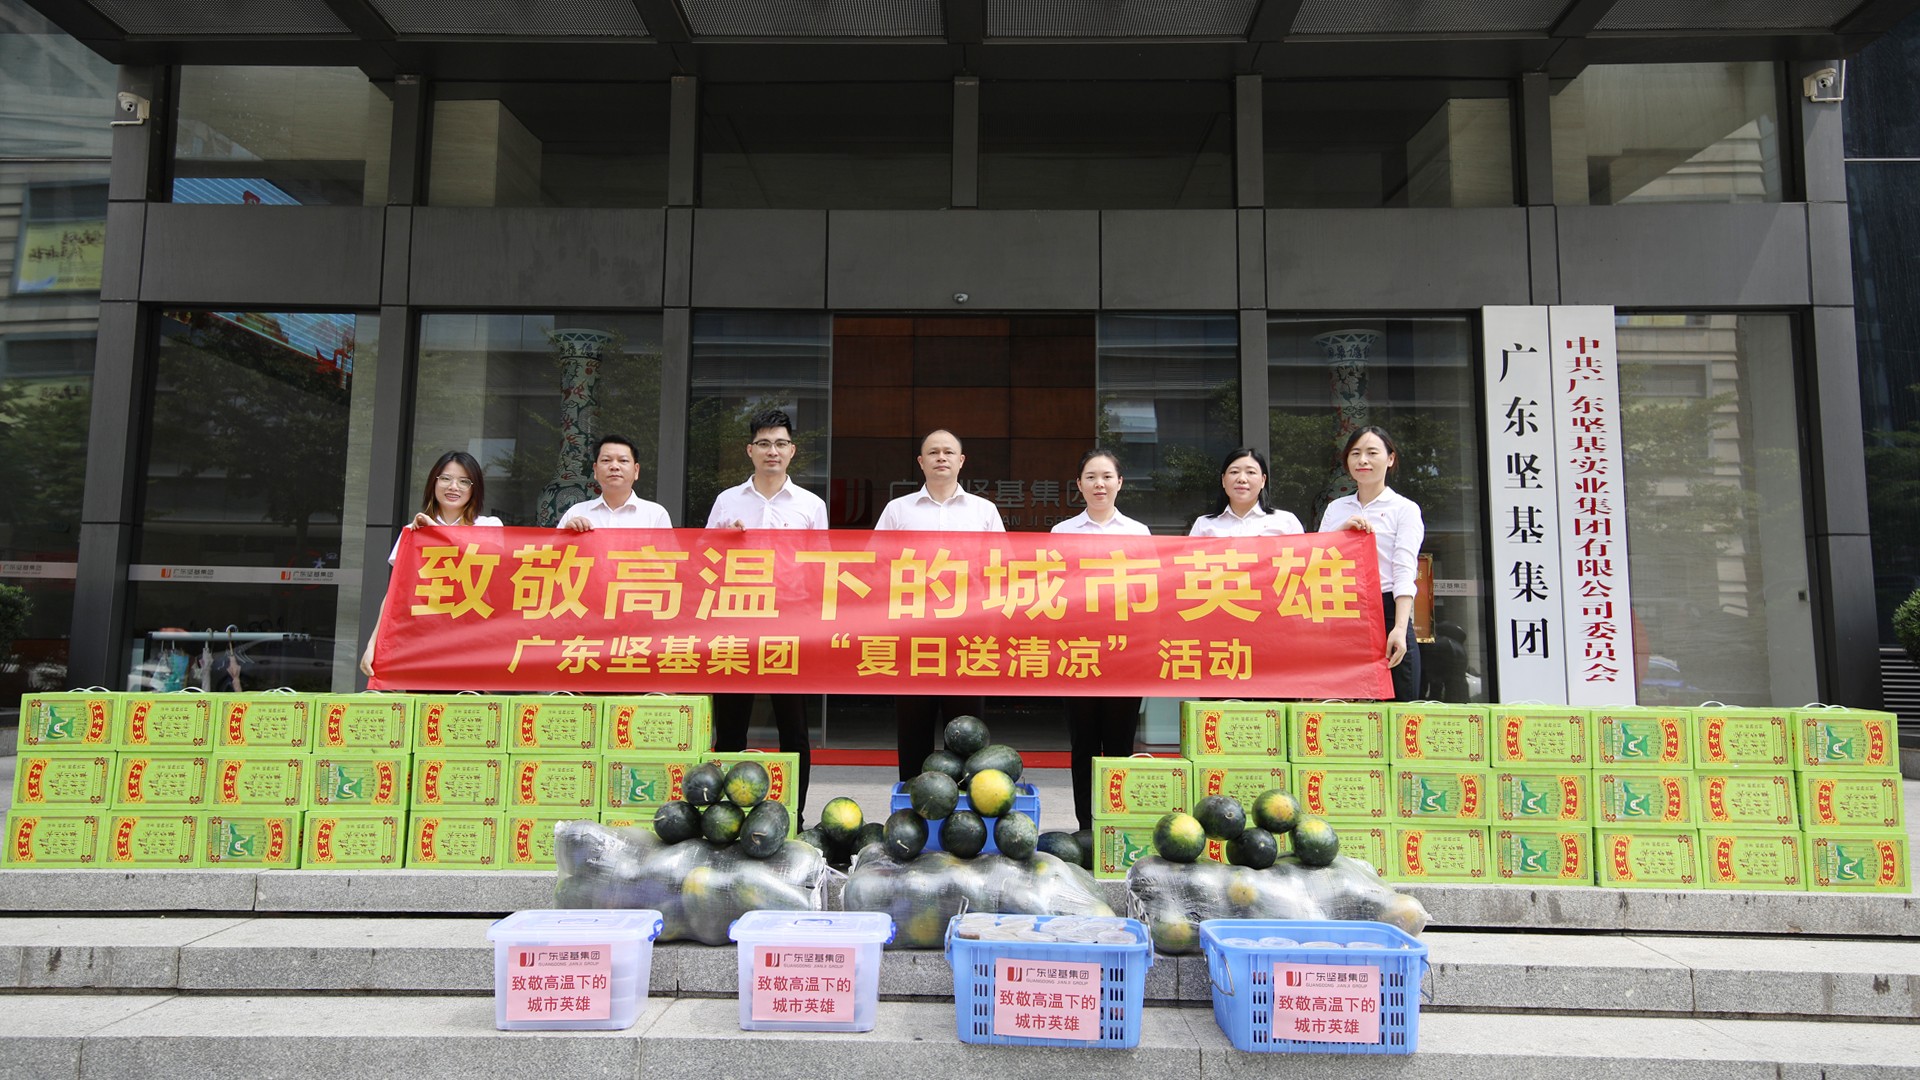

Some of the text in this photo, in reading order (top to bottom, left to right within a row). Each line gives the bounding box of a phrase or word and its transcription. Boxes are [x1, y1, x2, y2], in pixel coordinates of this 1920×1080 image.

[1499, 342, 1549, 660] 广东坚基集团
[1565, 336, 1619, 682] 中共广东坚基实业集团有限公司委员会
[412, 544, 1360, 622] 致敬高温下的城市英雄
[508, 635, 800, 676] 广东坚基集团
[1159, 640, 1254, 680] 活动
[538, 951, 600, 961] 广东坚基集团
[783, 953, 845, 963] 广东坚基集团
[512, 974, 607, 991] 致敬高温下的
[1026, 968, 1089, 980] 广东坚基集团
[1305, 972, 1369, 983] 广东坚基集团
[758, 975, 851, 992] 致敬高温下的
[527, 996, 591, 1012] 城市英雄
[772, 997, 835, 1014] 城市英雄
[1000, 990, 1096, 1010] 致敬高温下的
[1279, 995, 1376, 1013] 致敬高温下的
[1015, 1013, 1080, 1031] 城市英雄
[1294, 1017, 1360, 1035] 城市英雄
